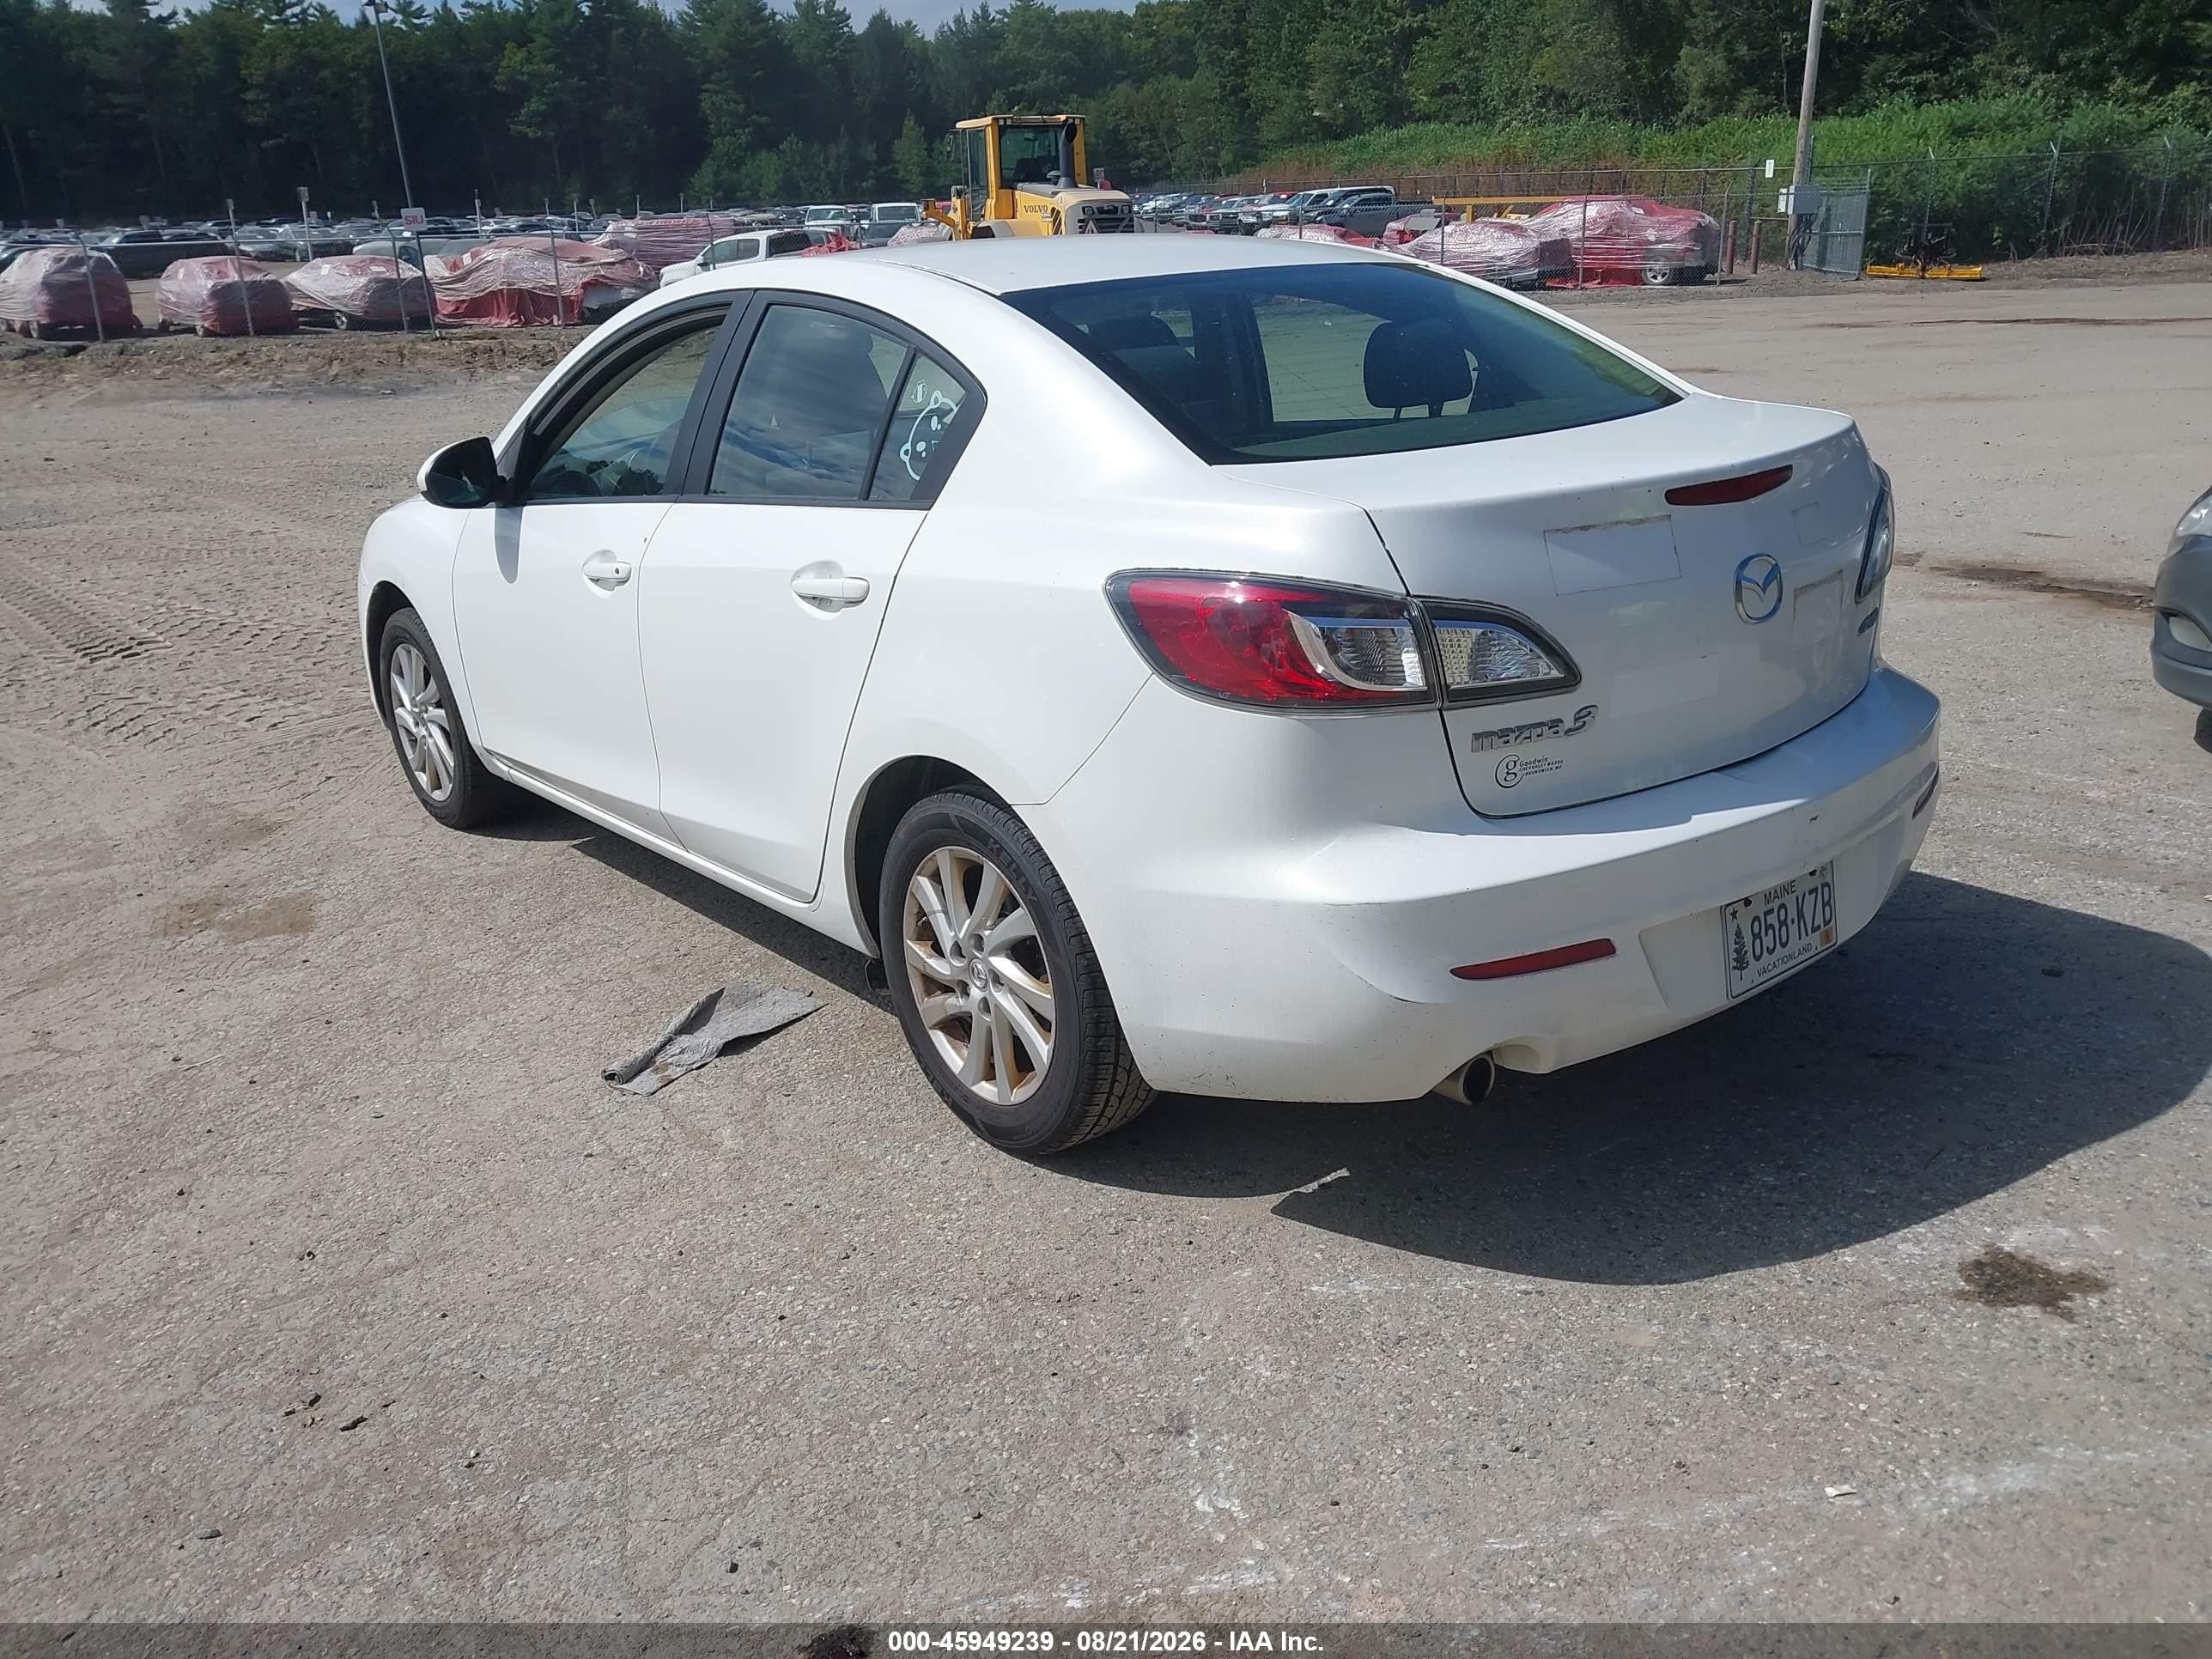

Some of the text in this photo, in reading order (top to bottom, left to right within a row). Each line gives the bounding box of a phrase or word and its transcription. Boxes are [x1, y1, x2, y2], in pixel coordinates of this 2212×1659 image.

[1023, 204, 1048, 213] VOLVO
[404, 214, 424, 225] SIU
[1519, 756, 1548, 767] Goodwin
[1764, 879, 1797, 907] MAINE
[1757, 942, 1813, 977] VACATIONLAND
